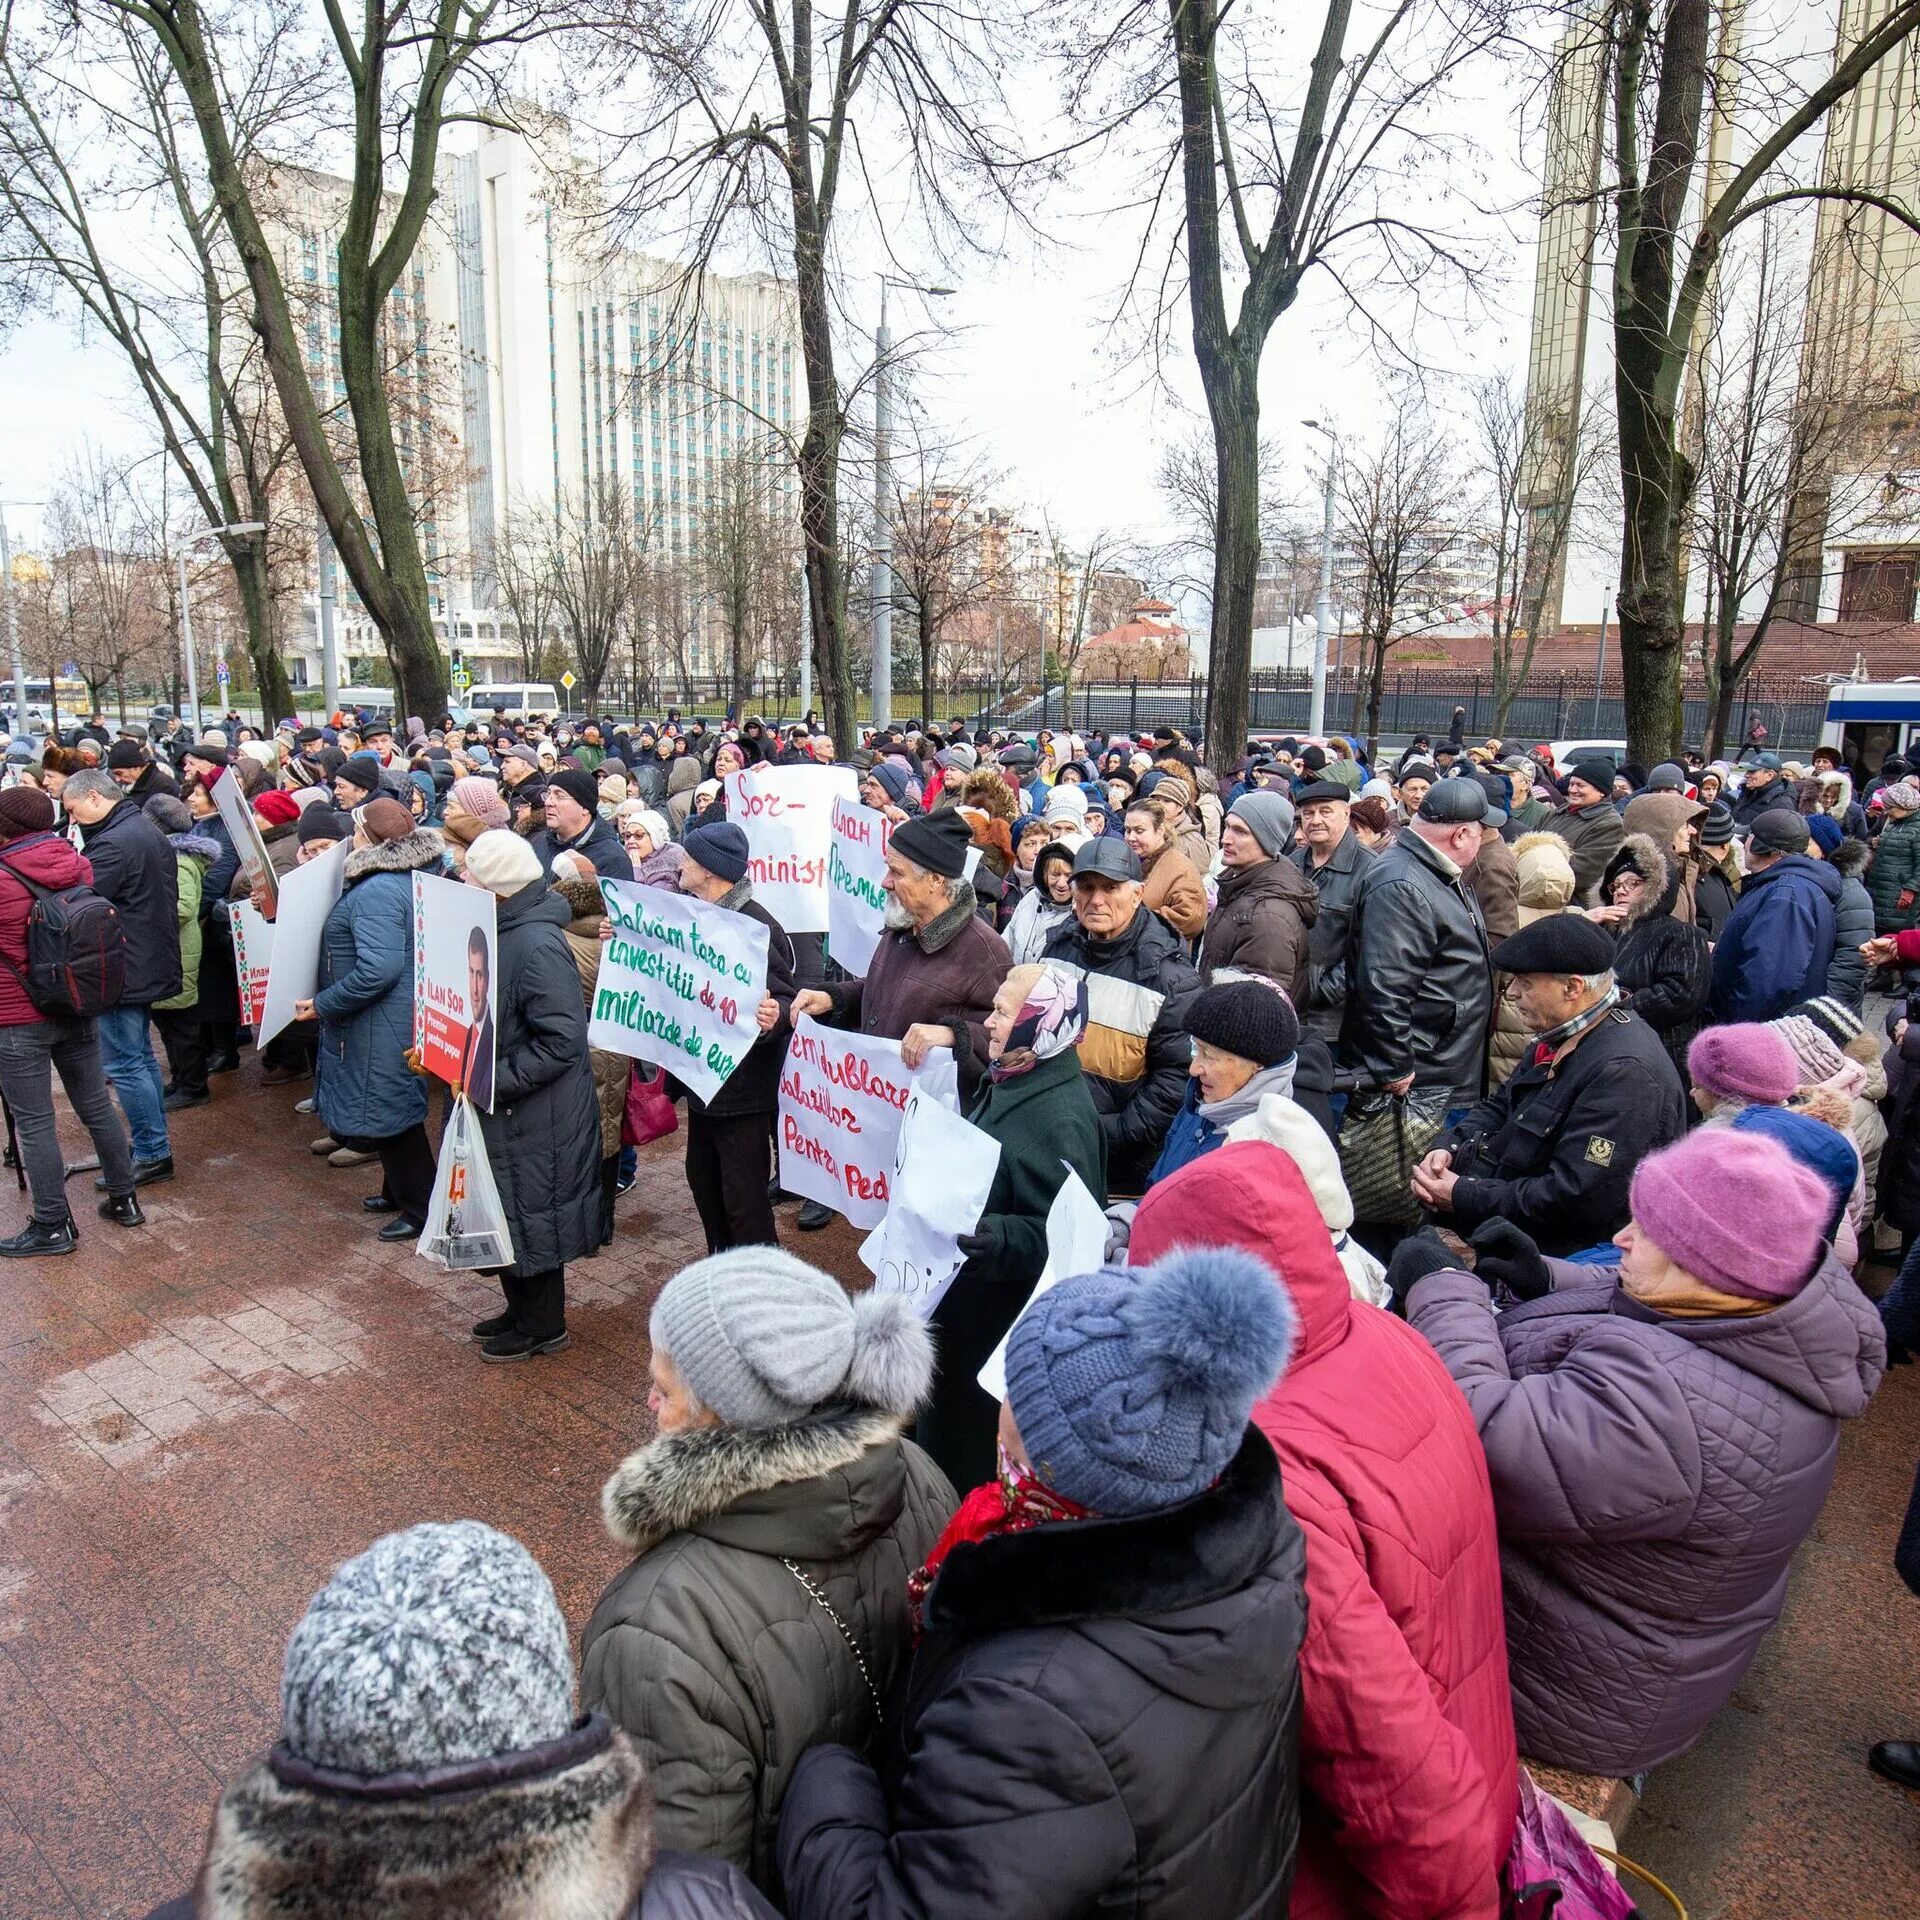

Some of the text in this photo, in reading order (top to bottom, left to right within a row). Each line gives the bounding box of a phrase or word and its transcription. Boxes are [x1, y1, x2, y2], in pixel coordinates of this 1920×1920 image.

[600, 878, 685, 953] Salvăm
[734, 962, 752, 987] cu
[427, 977, 464, 1016] ILAN ȘOR
[699, 980, 716, 1012] de
[720, 996, 738, 1025] 10
[427, 1011, 448, 1035] Premier
[596, 988, 681, 1047] miliarde
[684, 1025, 703, 1058] de
[426, 1032, 461, 1060] pentru popor
[784, 1113, 841, 1182] Pentru
